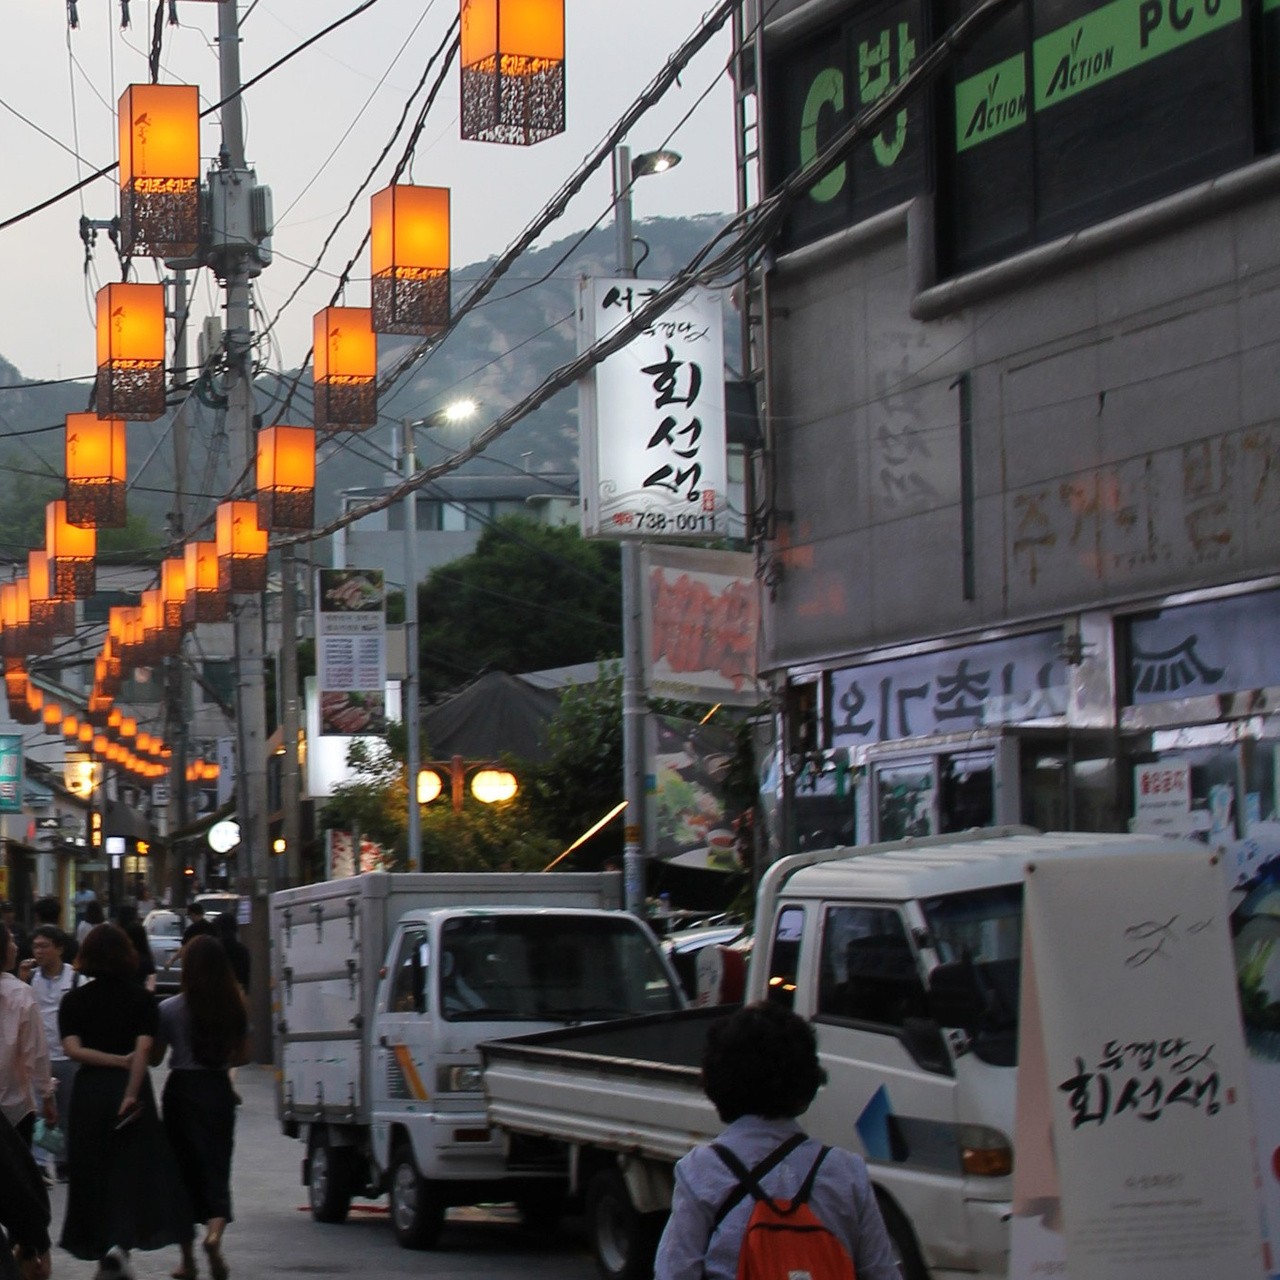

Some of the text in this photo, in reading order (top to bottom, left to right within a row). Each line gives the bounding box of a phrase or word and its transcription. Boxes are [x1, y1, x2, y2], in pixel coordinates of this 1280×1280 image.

[1046, 44, 1113, 98] ACTION
[965, 94, 1027, 139] ACTION
[641, 344, 702, 501] 회선생
[635, 512, 716, 531] 738-0011
[1058, 1056, 1221, 1129] 회선생
